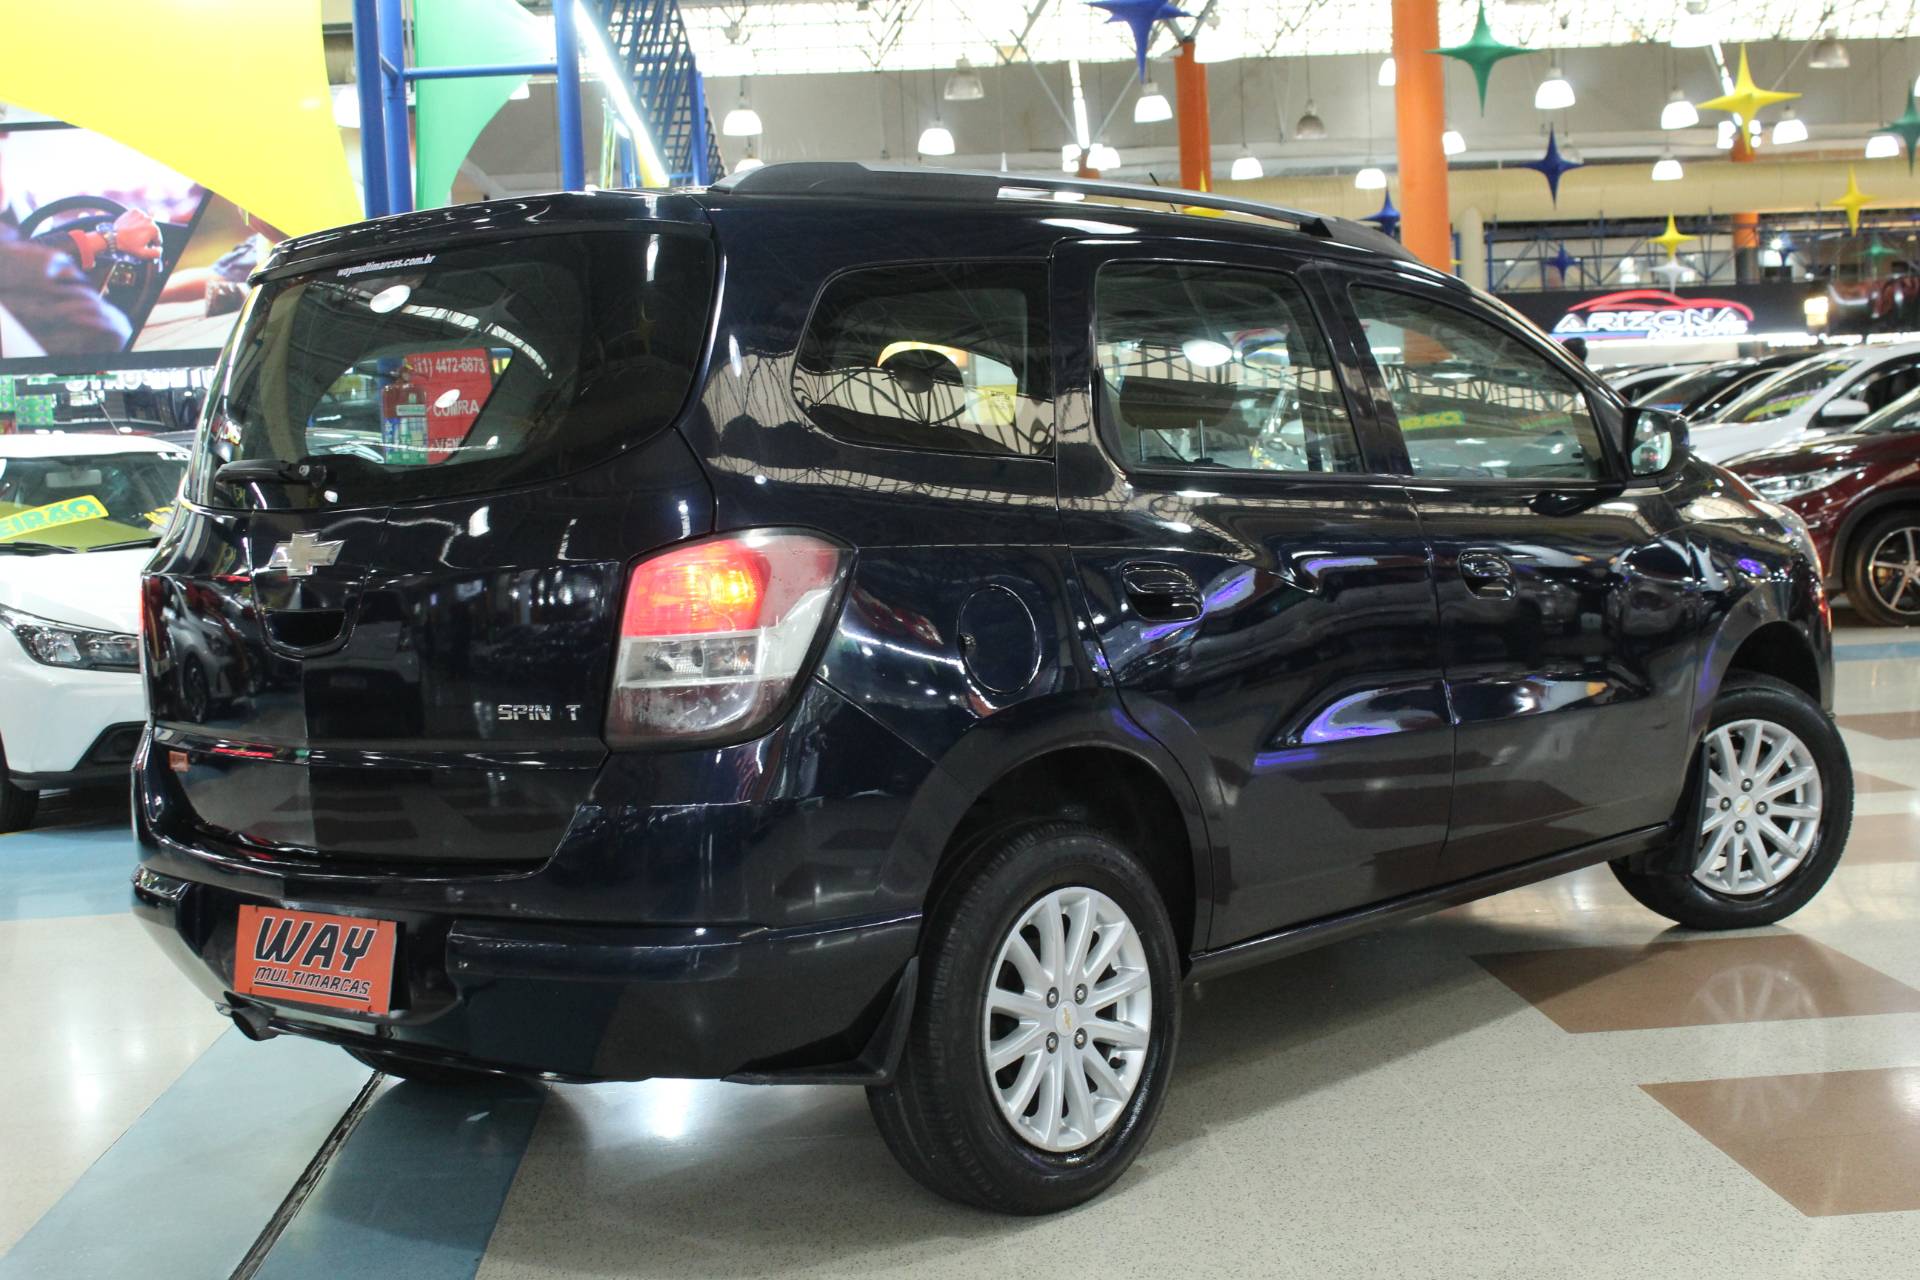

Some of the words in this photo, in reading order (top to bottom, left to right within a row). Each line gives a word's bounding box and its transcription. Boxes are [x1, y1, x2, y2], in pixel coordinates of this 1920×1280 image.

[1552, 307, 1748, 333] ARIZONA
[497, 704, 552, 721] SPIN
[565, 704, 581, 721] T
[254, 916, 377, 973] WAY
[255, 965, 371, 994] MULTIMARCAS
